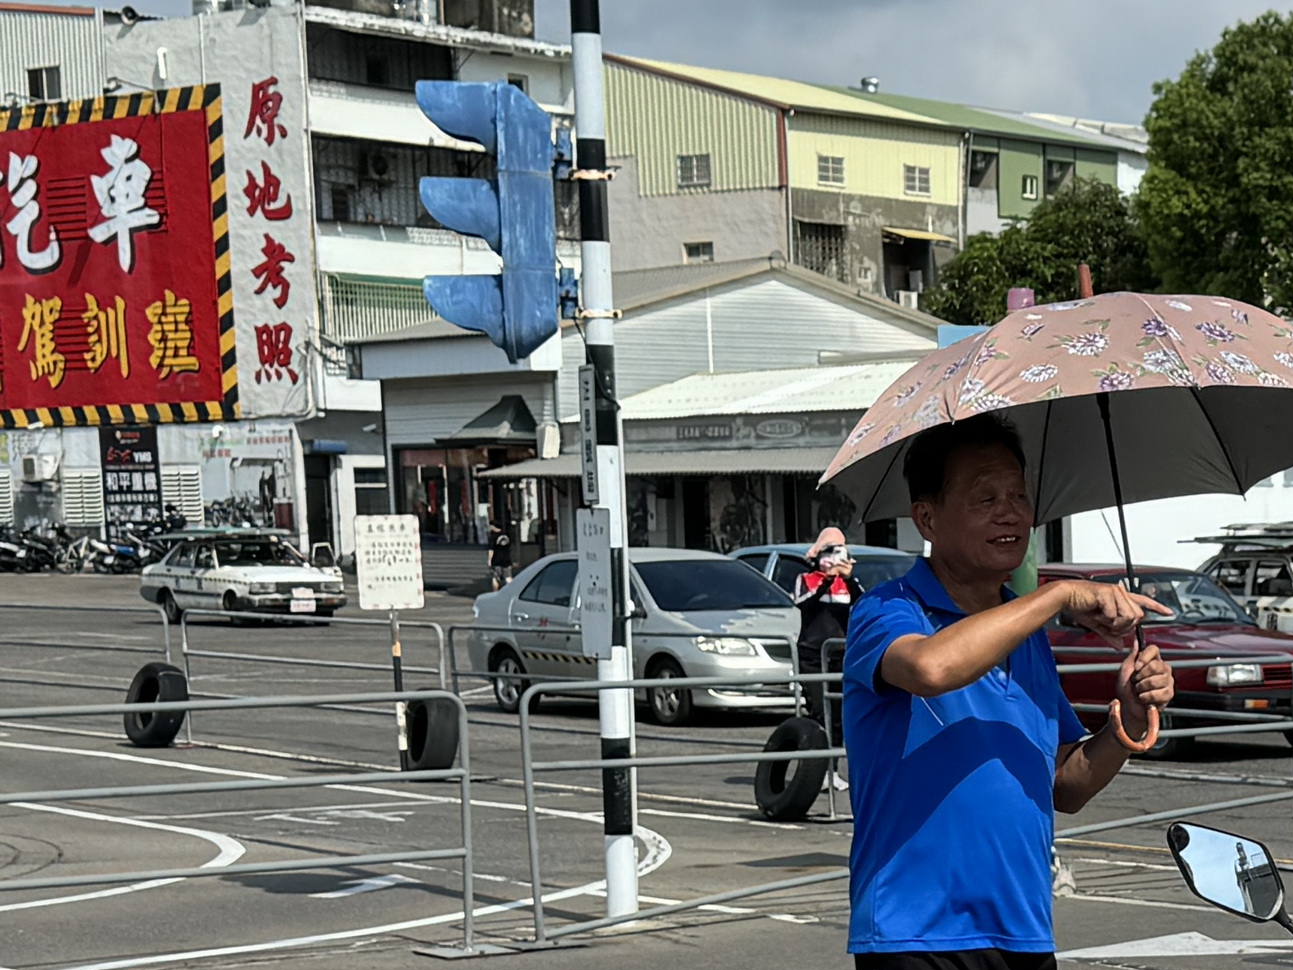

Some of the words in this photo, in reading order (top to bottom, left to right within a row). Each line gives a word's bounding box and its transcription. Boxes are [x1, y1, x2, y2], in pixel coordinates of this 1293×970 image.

[243, 76, 299, 386] 原地考照
[17, 289, 200, 389] 駕訓班
